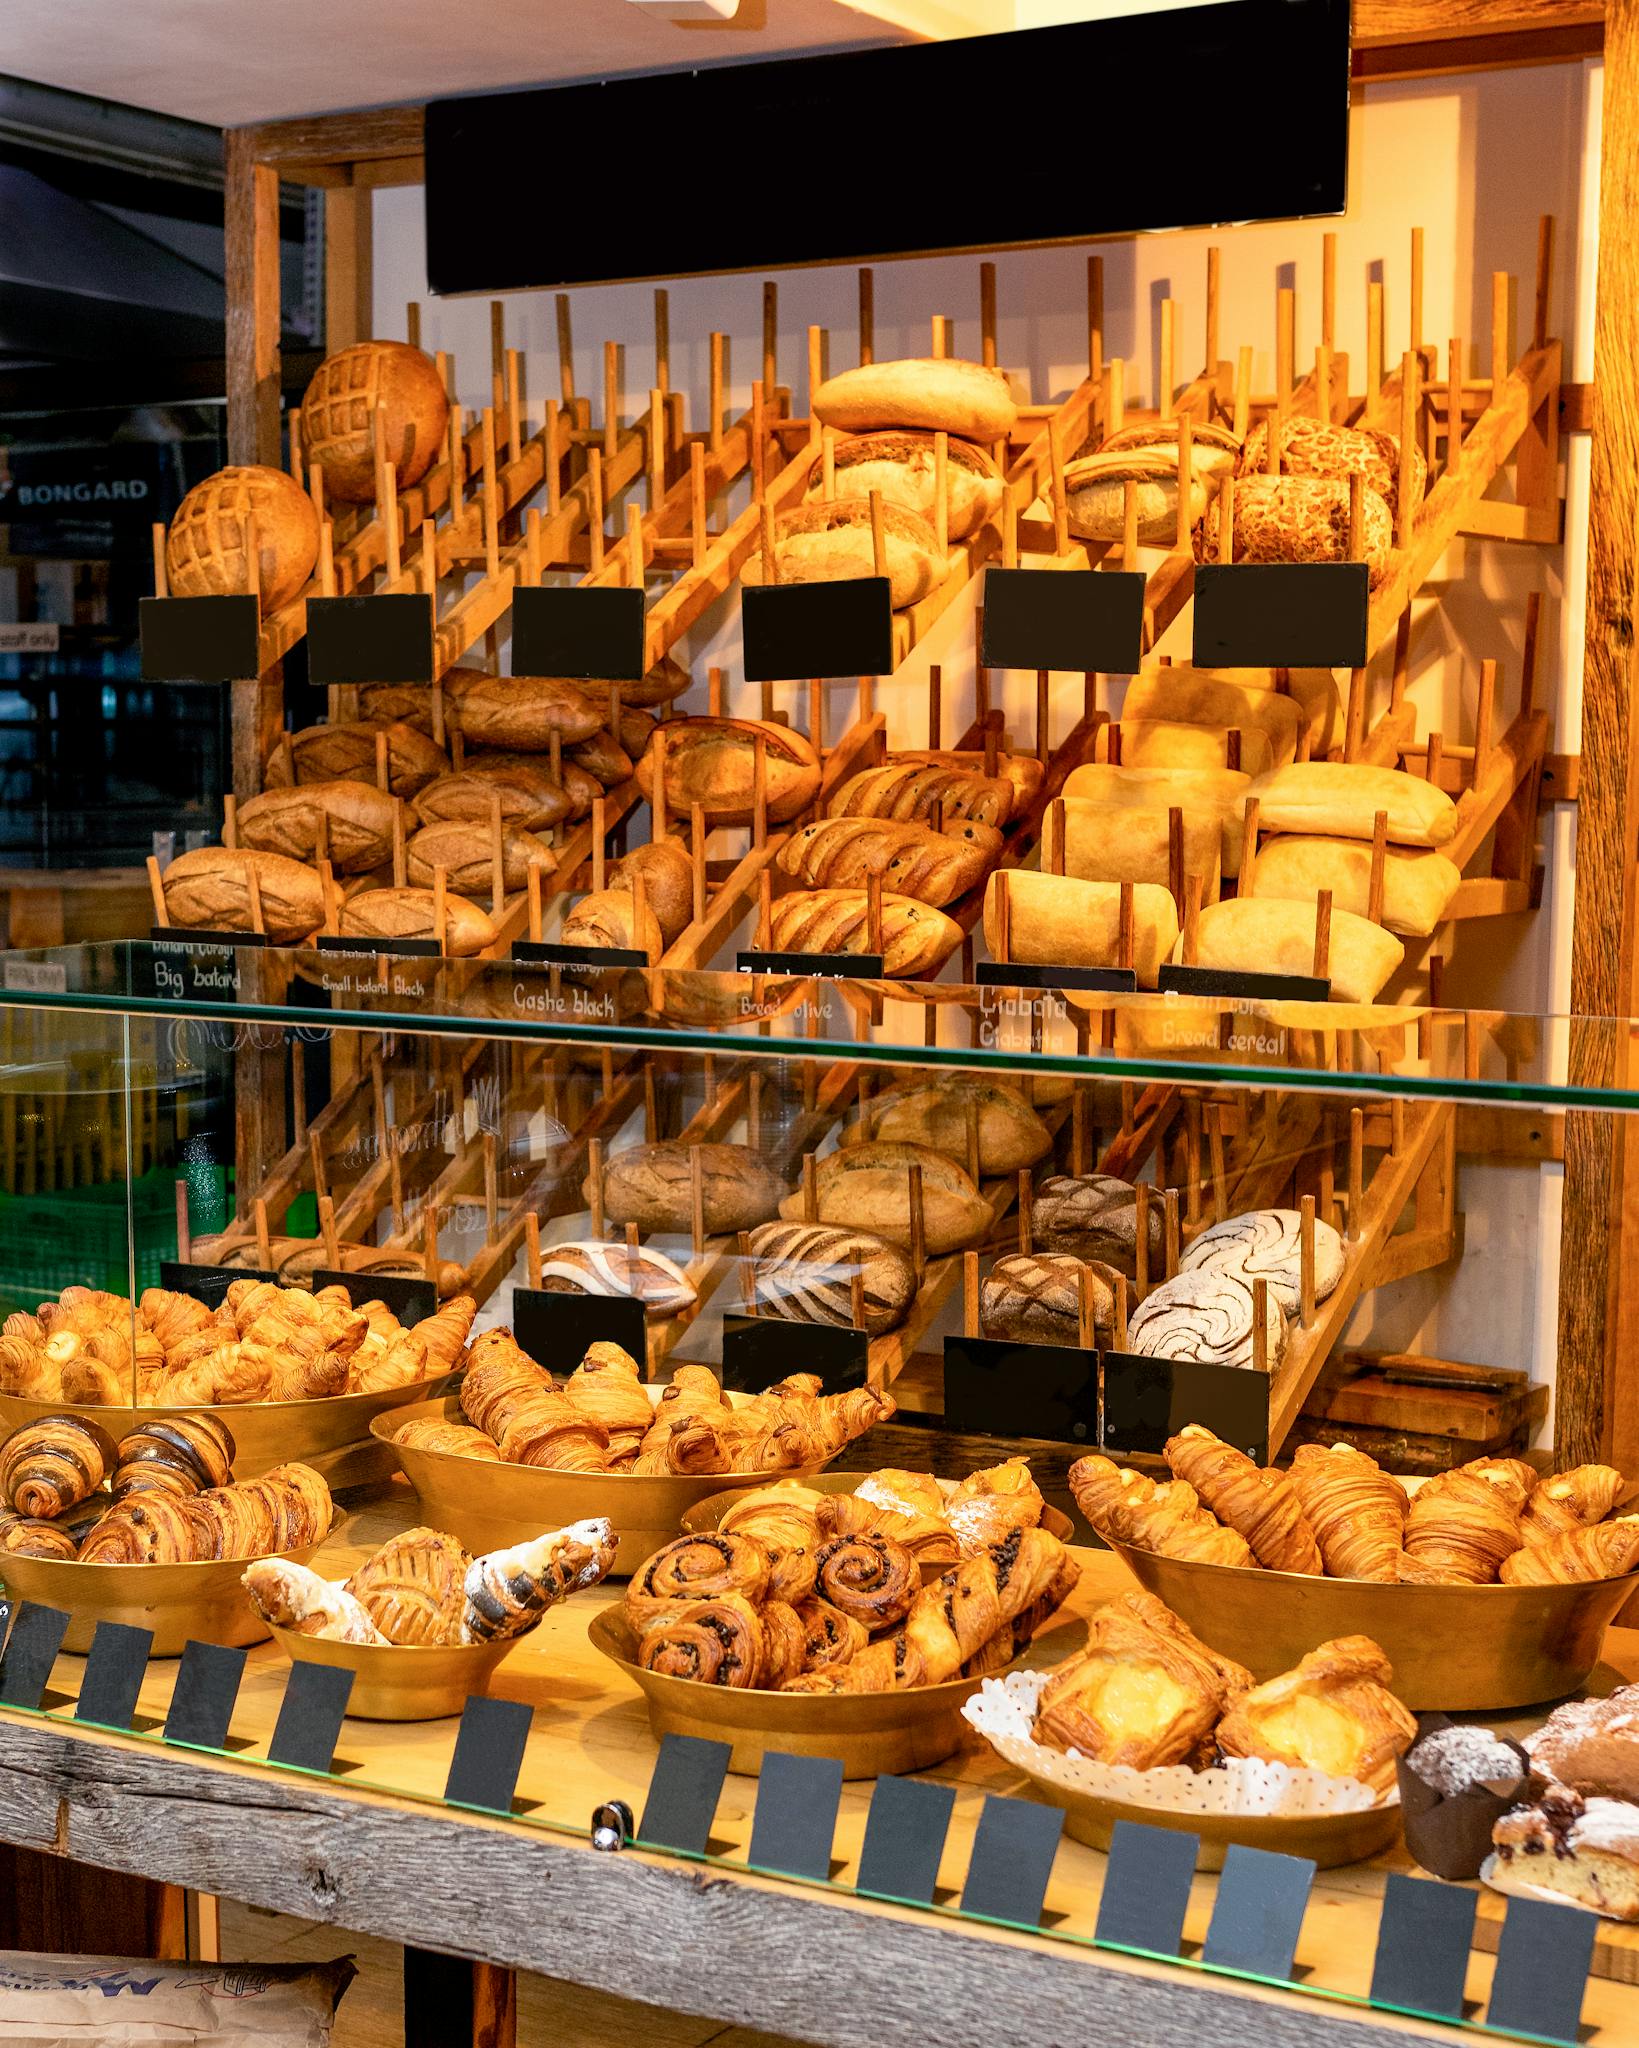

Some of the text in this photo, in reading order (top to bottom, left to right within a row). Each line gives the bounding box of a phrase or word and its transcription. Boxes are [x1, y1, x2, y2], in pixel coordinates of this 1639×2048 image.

[18, 480, 148, 504] BONGARD
[154, 960, 241, 998] Big batard
[322, 973, 350, 992] Small
[356, 975, 388, 995] batard
[572, 989, 614, 1018] black
[794, 998, 833, 1019] olive
[1162, 1020, 1285, 1055] Bread cereal
